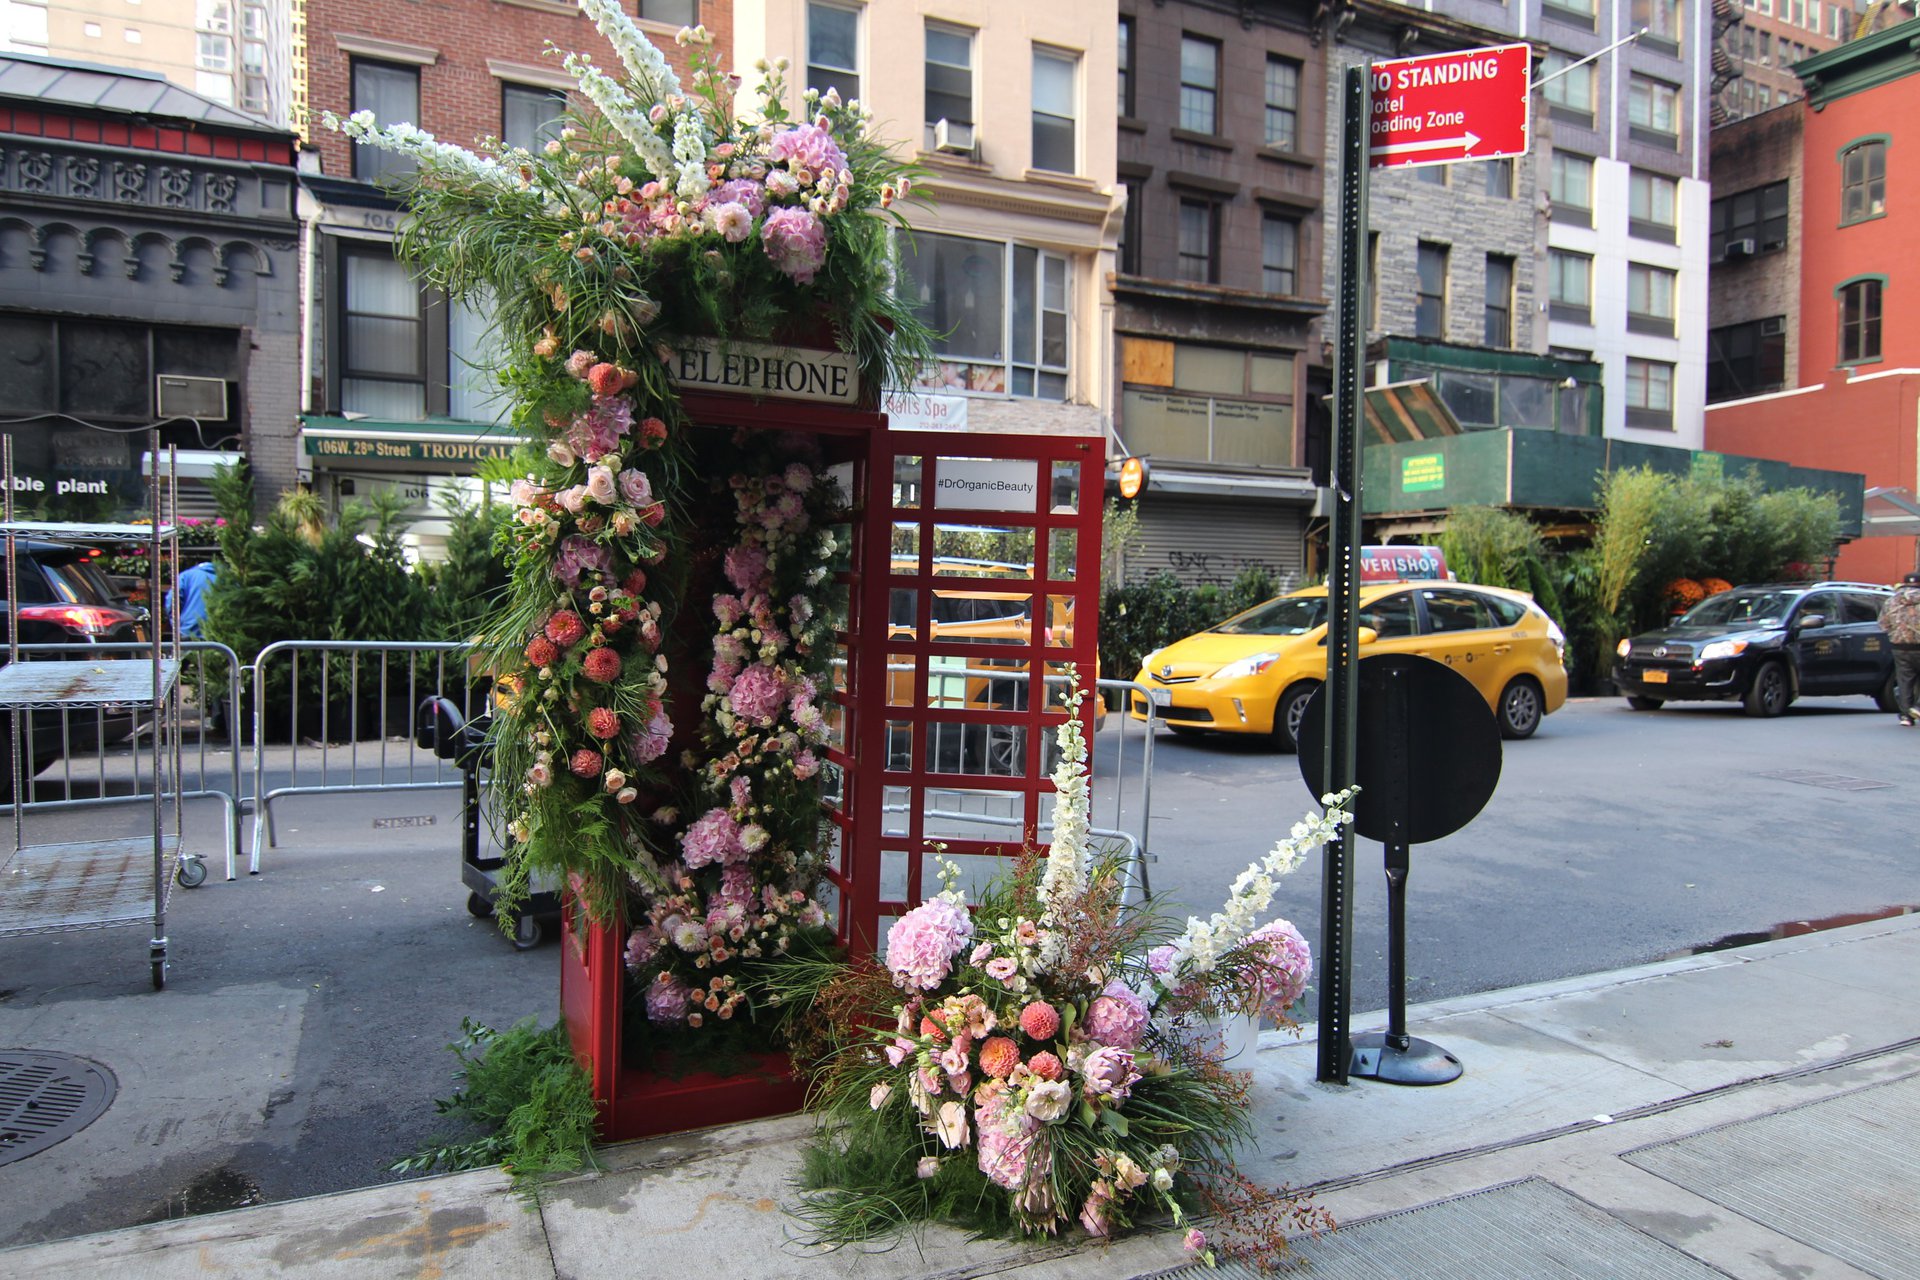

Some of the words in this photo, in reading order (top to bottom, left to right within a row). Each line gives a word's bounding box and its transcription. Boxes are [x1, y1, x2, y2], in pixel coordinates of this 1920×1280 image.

[1397, 58, 1498, 90] STANDING
[1371, 95, 1404, 114] otel
[1371, 115, 1422, 134] oading
[1426, 111, 1465, 128] Zone
[363, 211, 395, 230] 106
[925, 398, 947, 420] Spa
[317, 440, 351, 454] 106W.
[376, 442, 411, 457] Street
[57, 478, 108, 495] plant
[405, 489, 429, 498] 106
[938, 478, 1033, 493] #DrOrganicBeauty
[1361, 558, 1439, 572] VERISHOP
